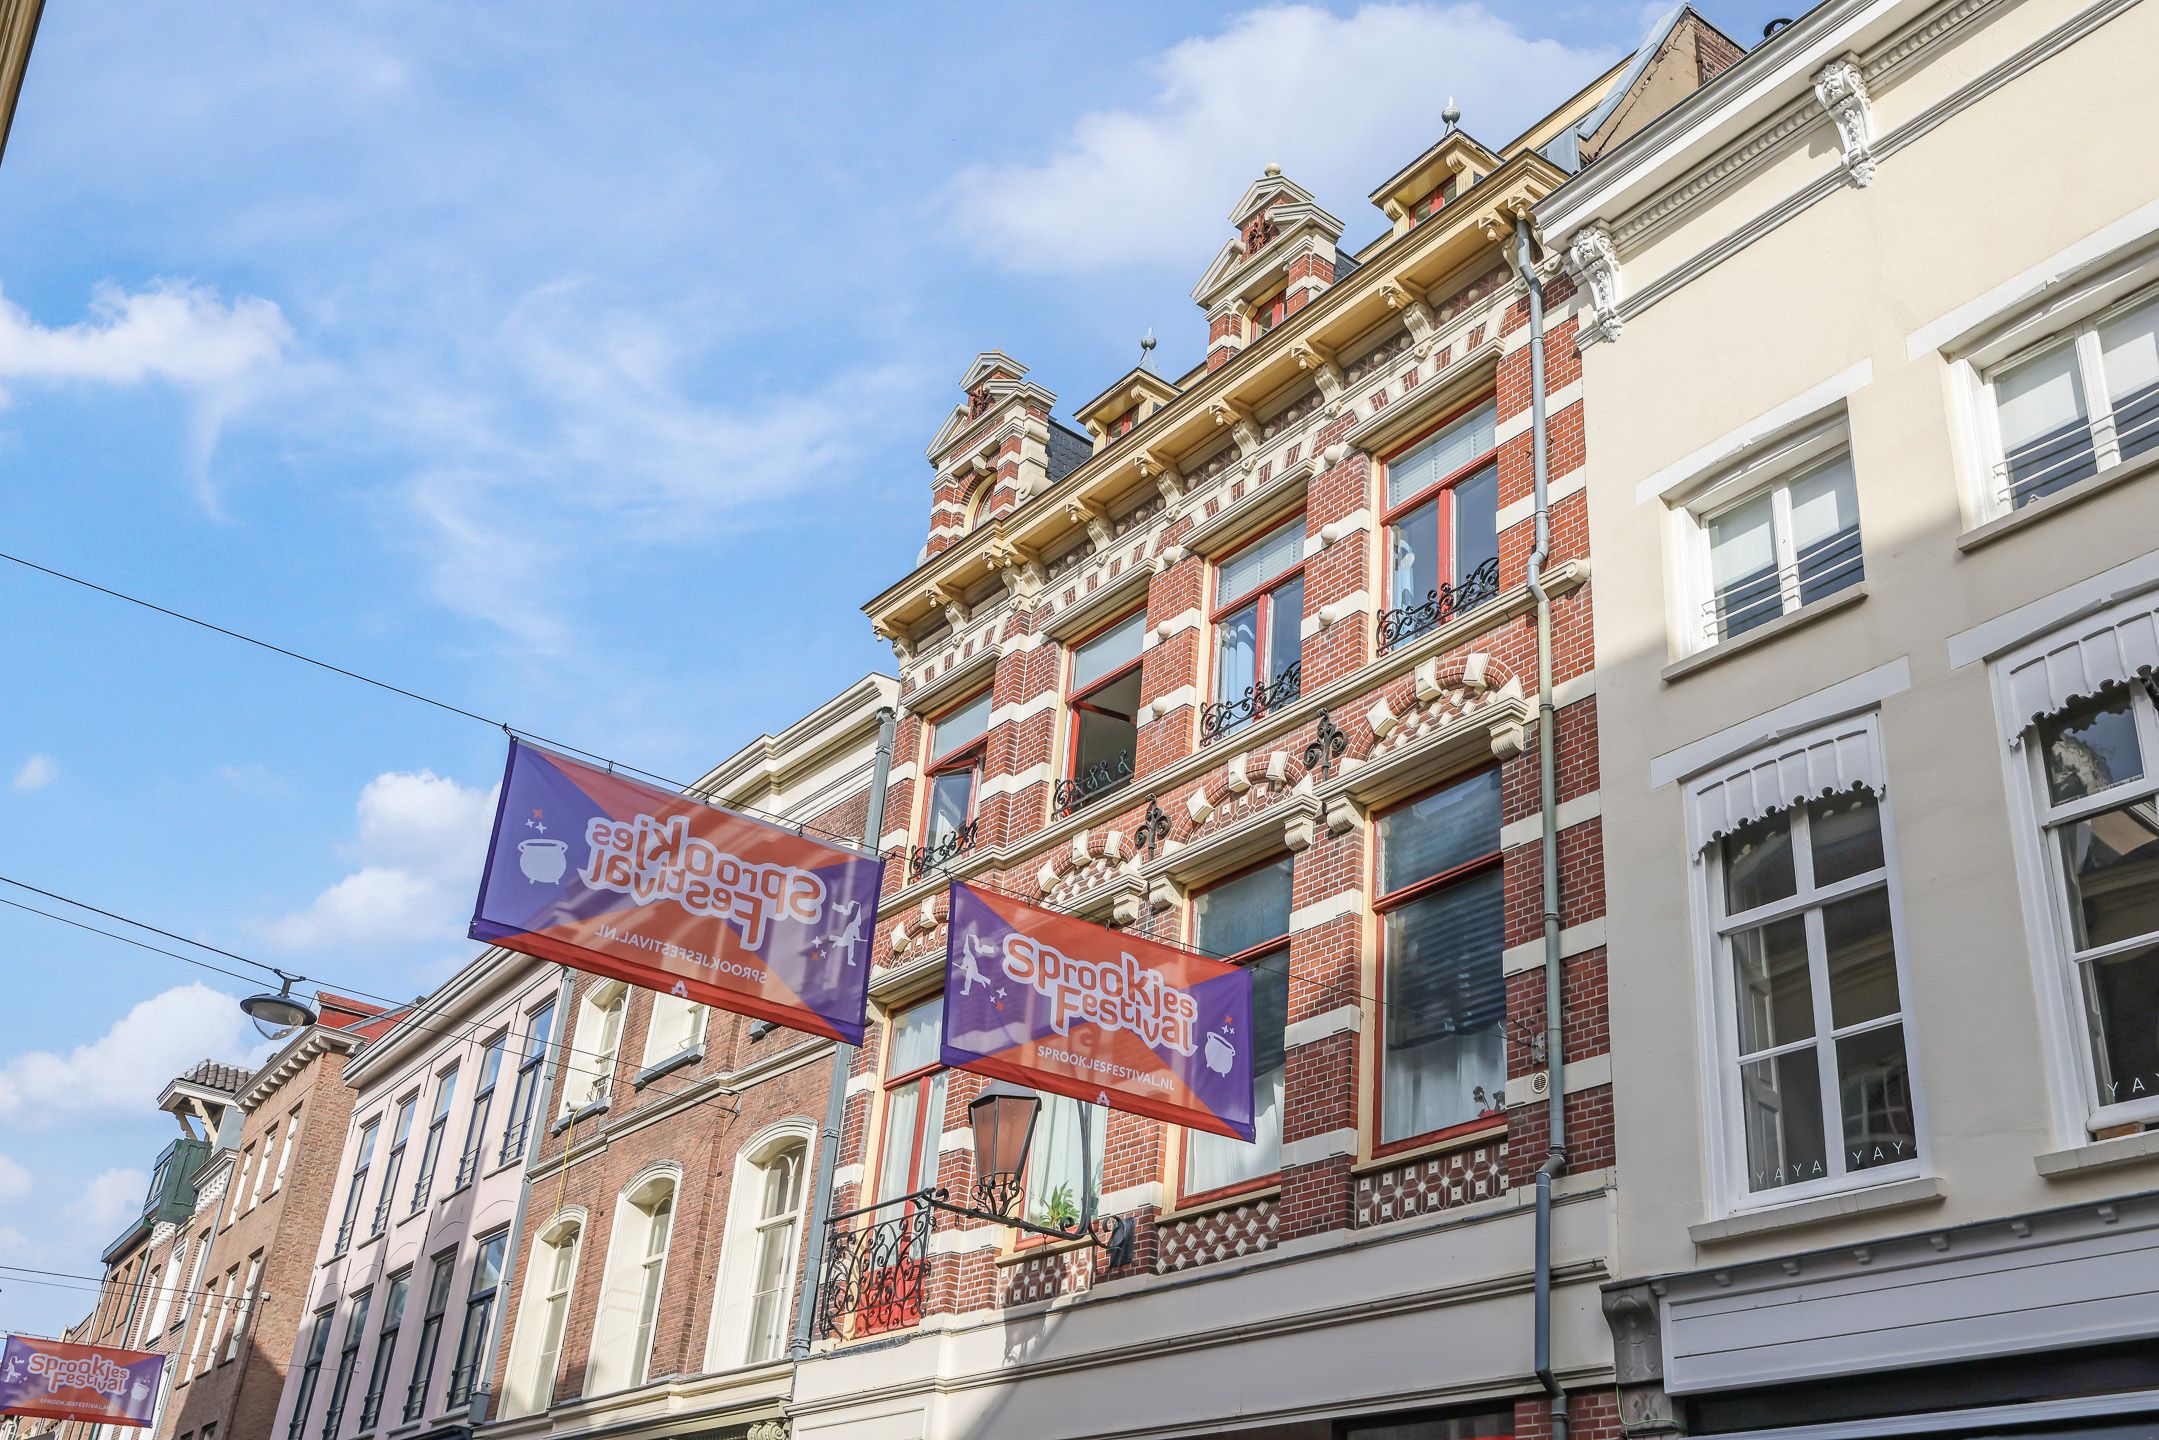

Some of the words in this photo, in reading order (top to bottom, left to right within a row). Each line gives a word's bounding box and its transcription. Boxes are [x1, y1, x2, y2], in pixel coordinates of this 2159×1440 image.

[1006, 938, 1195, 1020] Sprookjes
[1055, 983, 1191, 1051] Festival
[1037, 1045, 1176, 1092] SPROOKJESFESTIVAL.NL
[2106, 1072, 2159, 1097] YA
[1852, 1140, 1918, 1164] YAY
[29, 1354, 128, 1381] Sprookjes
[51, 1371, 125, 1393] Festival
